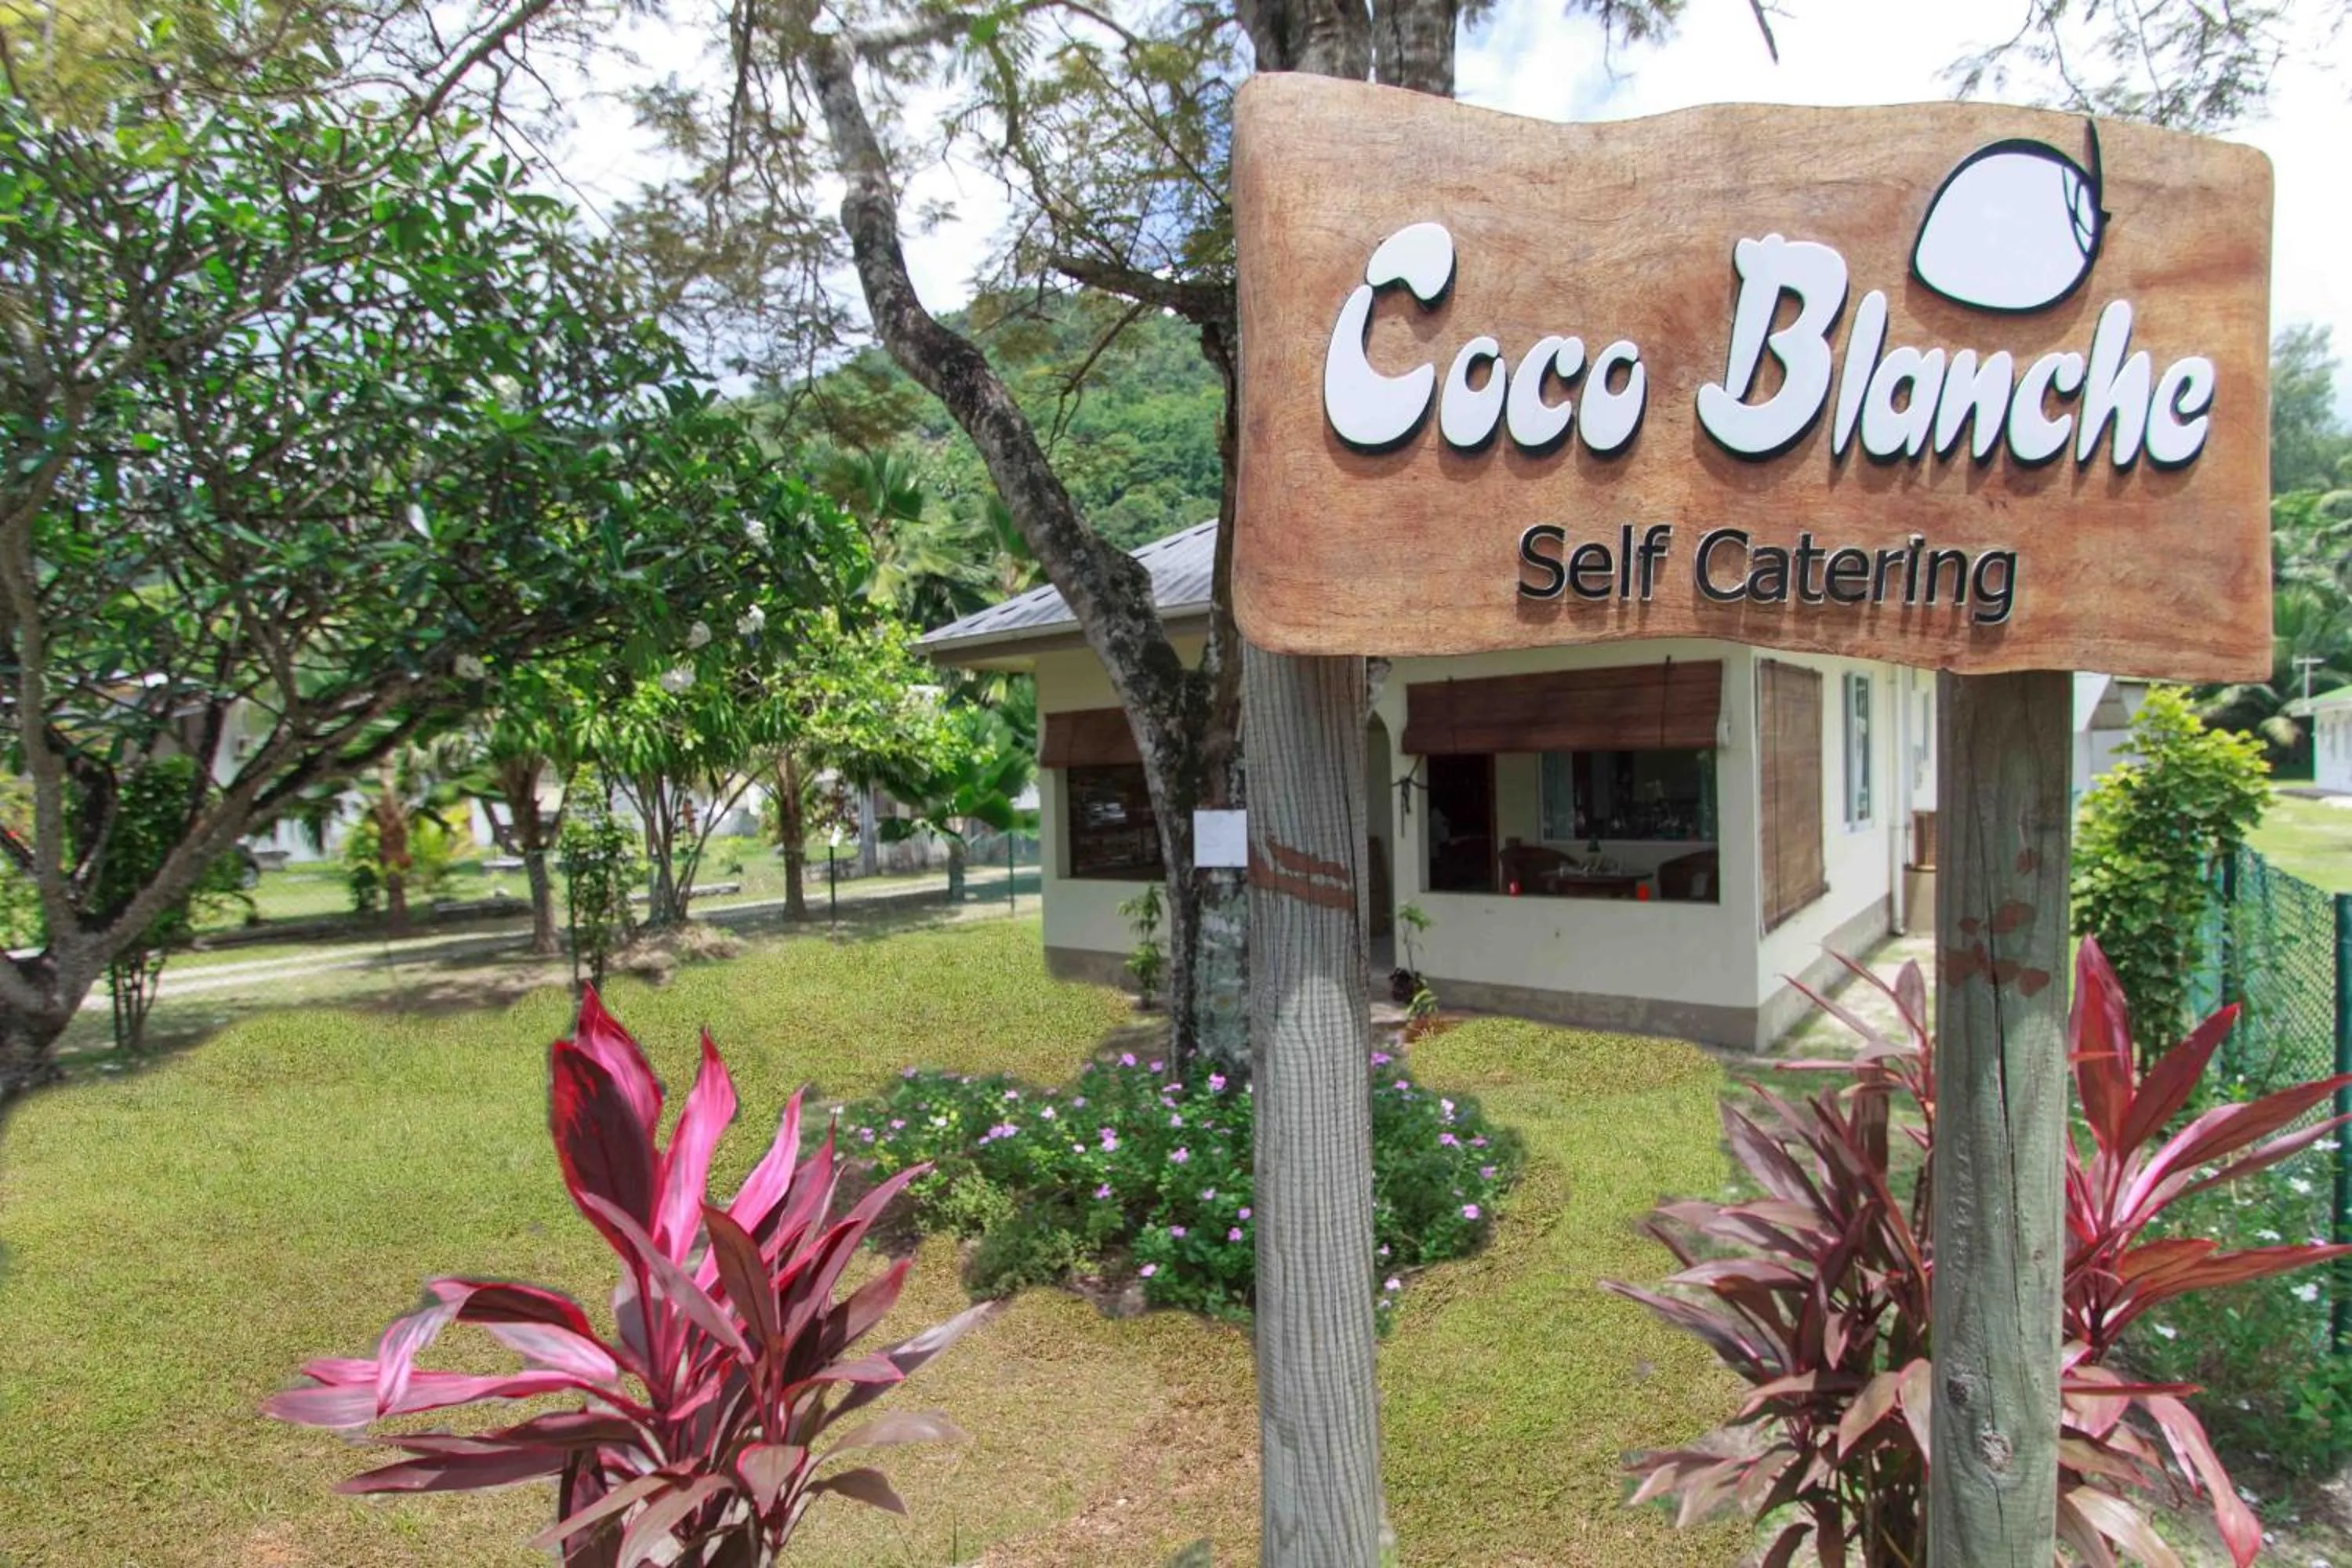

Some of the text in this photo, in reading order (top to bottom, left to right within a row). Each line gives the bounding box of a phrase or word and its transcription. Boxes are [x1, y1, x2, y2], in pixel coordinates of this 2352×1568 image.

[1323, 222, 2214, 468] Coco Blanche
[1519, 524, 2016, 623] Self Catering
